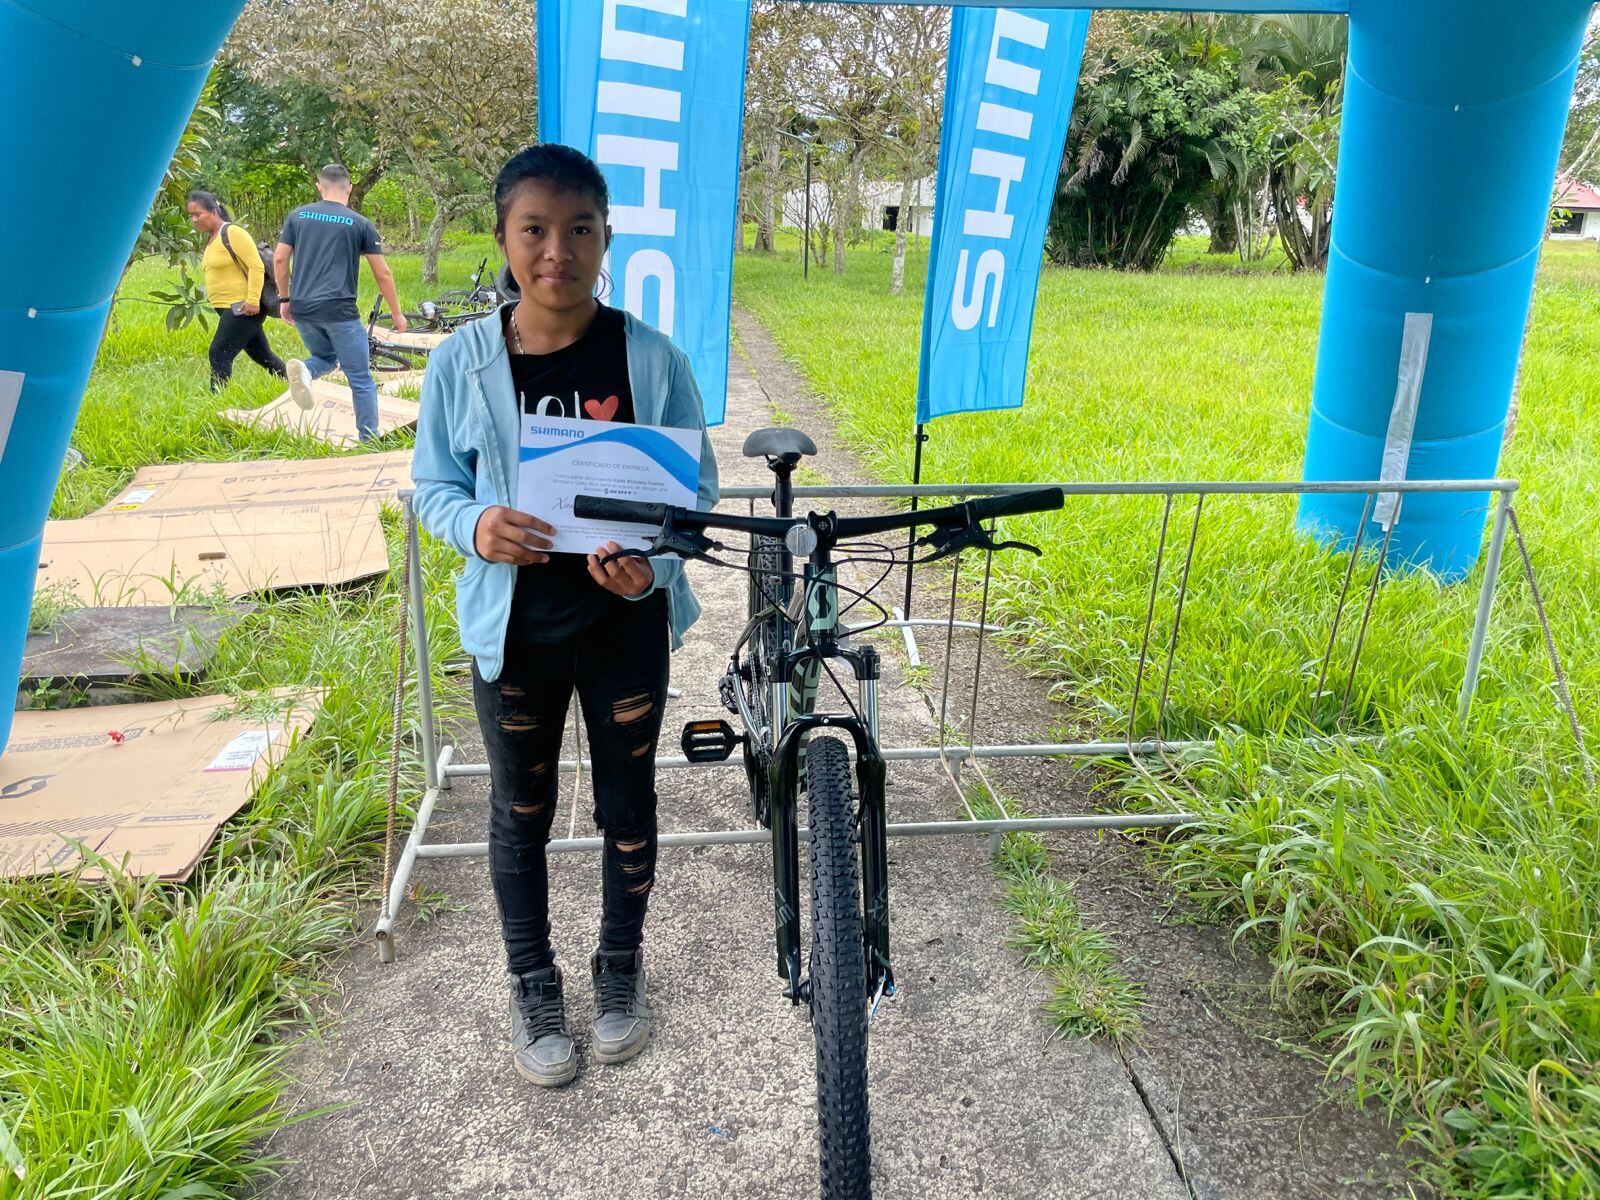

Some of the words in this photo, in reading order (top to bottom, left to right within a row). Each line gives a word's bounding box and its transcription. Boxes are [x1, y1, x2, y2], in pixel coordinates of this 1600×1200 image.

[299, 211, 354, 226] SHIMANO
[530, 426, 585, 438] SHIMANO
[572, 460, 611, 470] CERTIFICADO
[622, 464, 650, 472] ENTREGA
